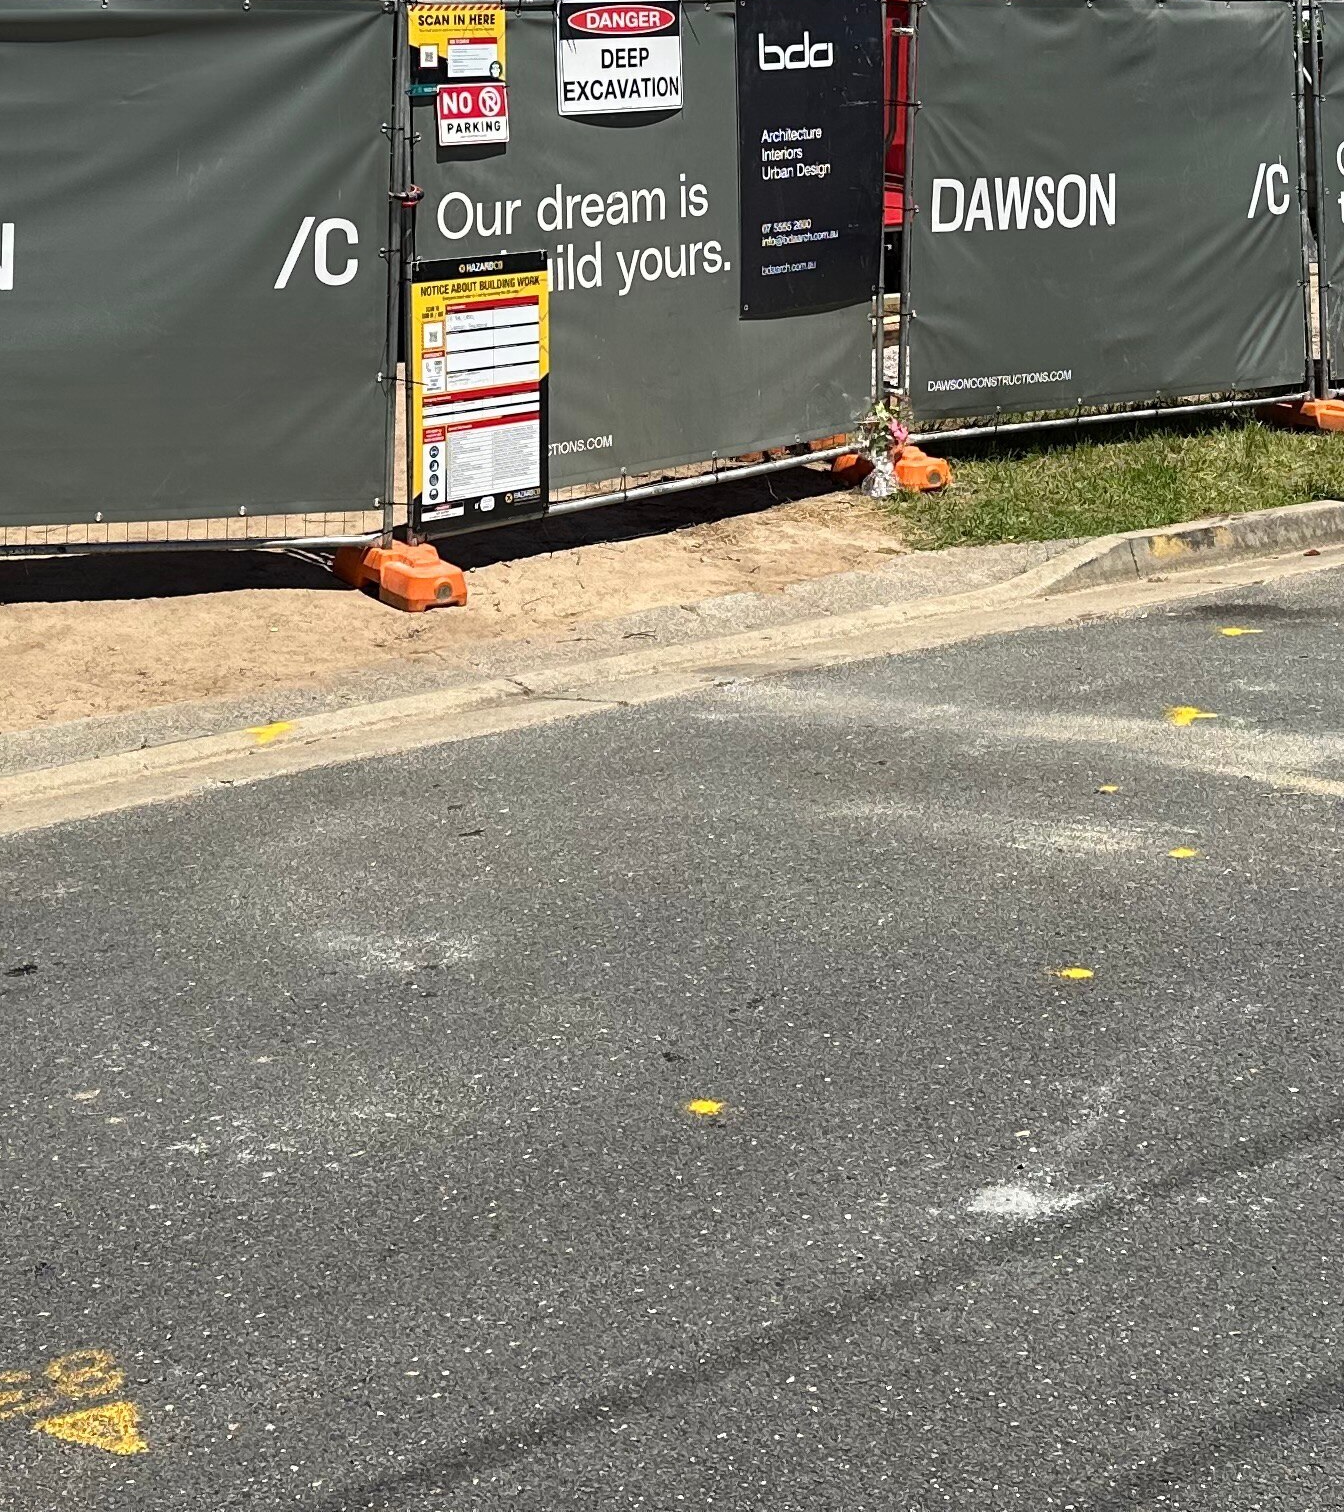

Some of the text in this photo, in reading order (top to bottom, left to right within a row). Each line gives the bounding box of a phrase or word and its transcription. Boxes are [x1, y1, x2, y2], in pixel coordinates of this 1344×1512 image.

[418, 13, 496, 26] SCAN IN HERE
[586, 10, 661, 29] DANGER
[601, 47, 650, 69] DEEP
[758, 31, 834, 71] bda
[564, 76, 680, 101] EXCAVATION
[442, 91, 472, 115] NO
[447, 121, 501, 134] PARKING
[761, 128, 822, 143] Architecture
[761, 147, 803, 161] Interiors
[761, 163, 831, 180] Urban Design
[437, 173, 709, 240] Our dream is
[930, 163, 1290, 234] DAWSON /C
[274, 216, 359, 289] /C
[617, 239, 731, 296] yours.
[421, 285, 450, 297] NOTICE
[451, 281, 477, 294] ABOUT
[479, 278, 515, 291] BUILDING
[517, 275, 540, 287] WORK
[927, 369, 1072, 392] DAWSONCONSTRUCTIONS.COM
